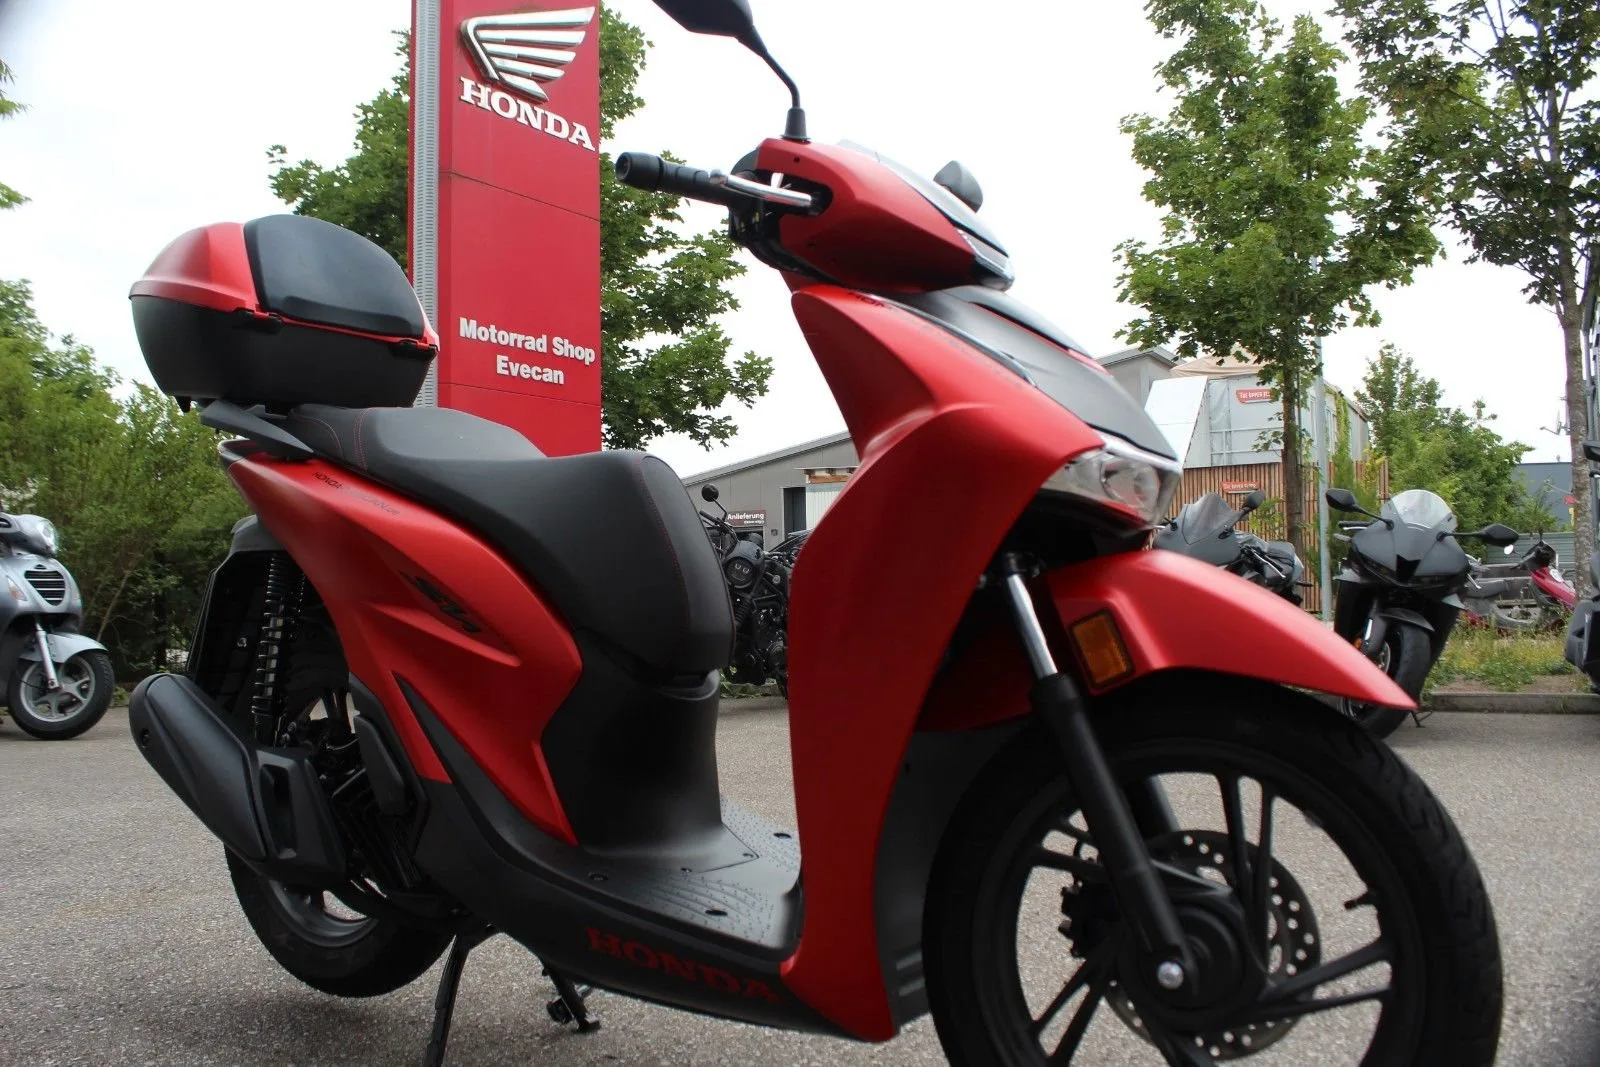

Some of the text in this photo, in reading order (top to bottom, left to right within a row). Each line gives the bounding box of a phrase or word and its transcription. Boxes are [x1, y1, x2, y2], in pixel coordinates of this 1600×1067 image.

[460, 76, 596, 152] HONDA
[459, 317, 596, 366] Motorrad Shop
[496, 354, 565, 385] Evecan
[727, 512, 765, 520] Anlieferung
[586, 927, 788, 1005] HONDA
